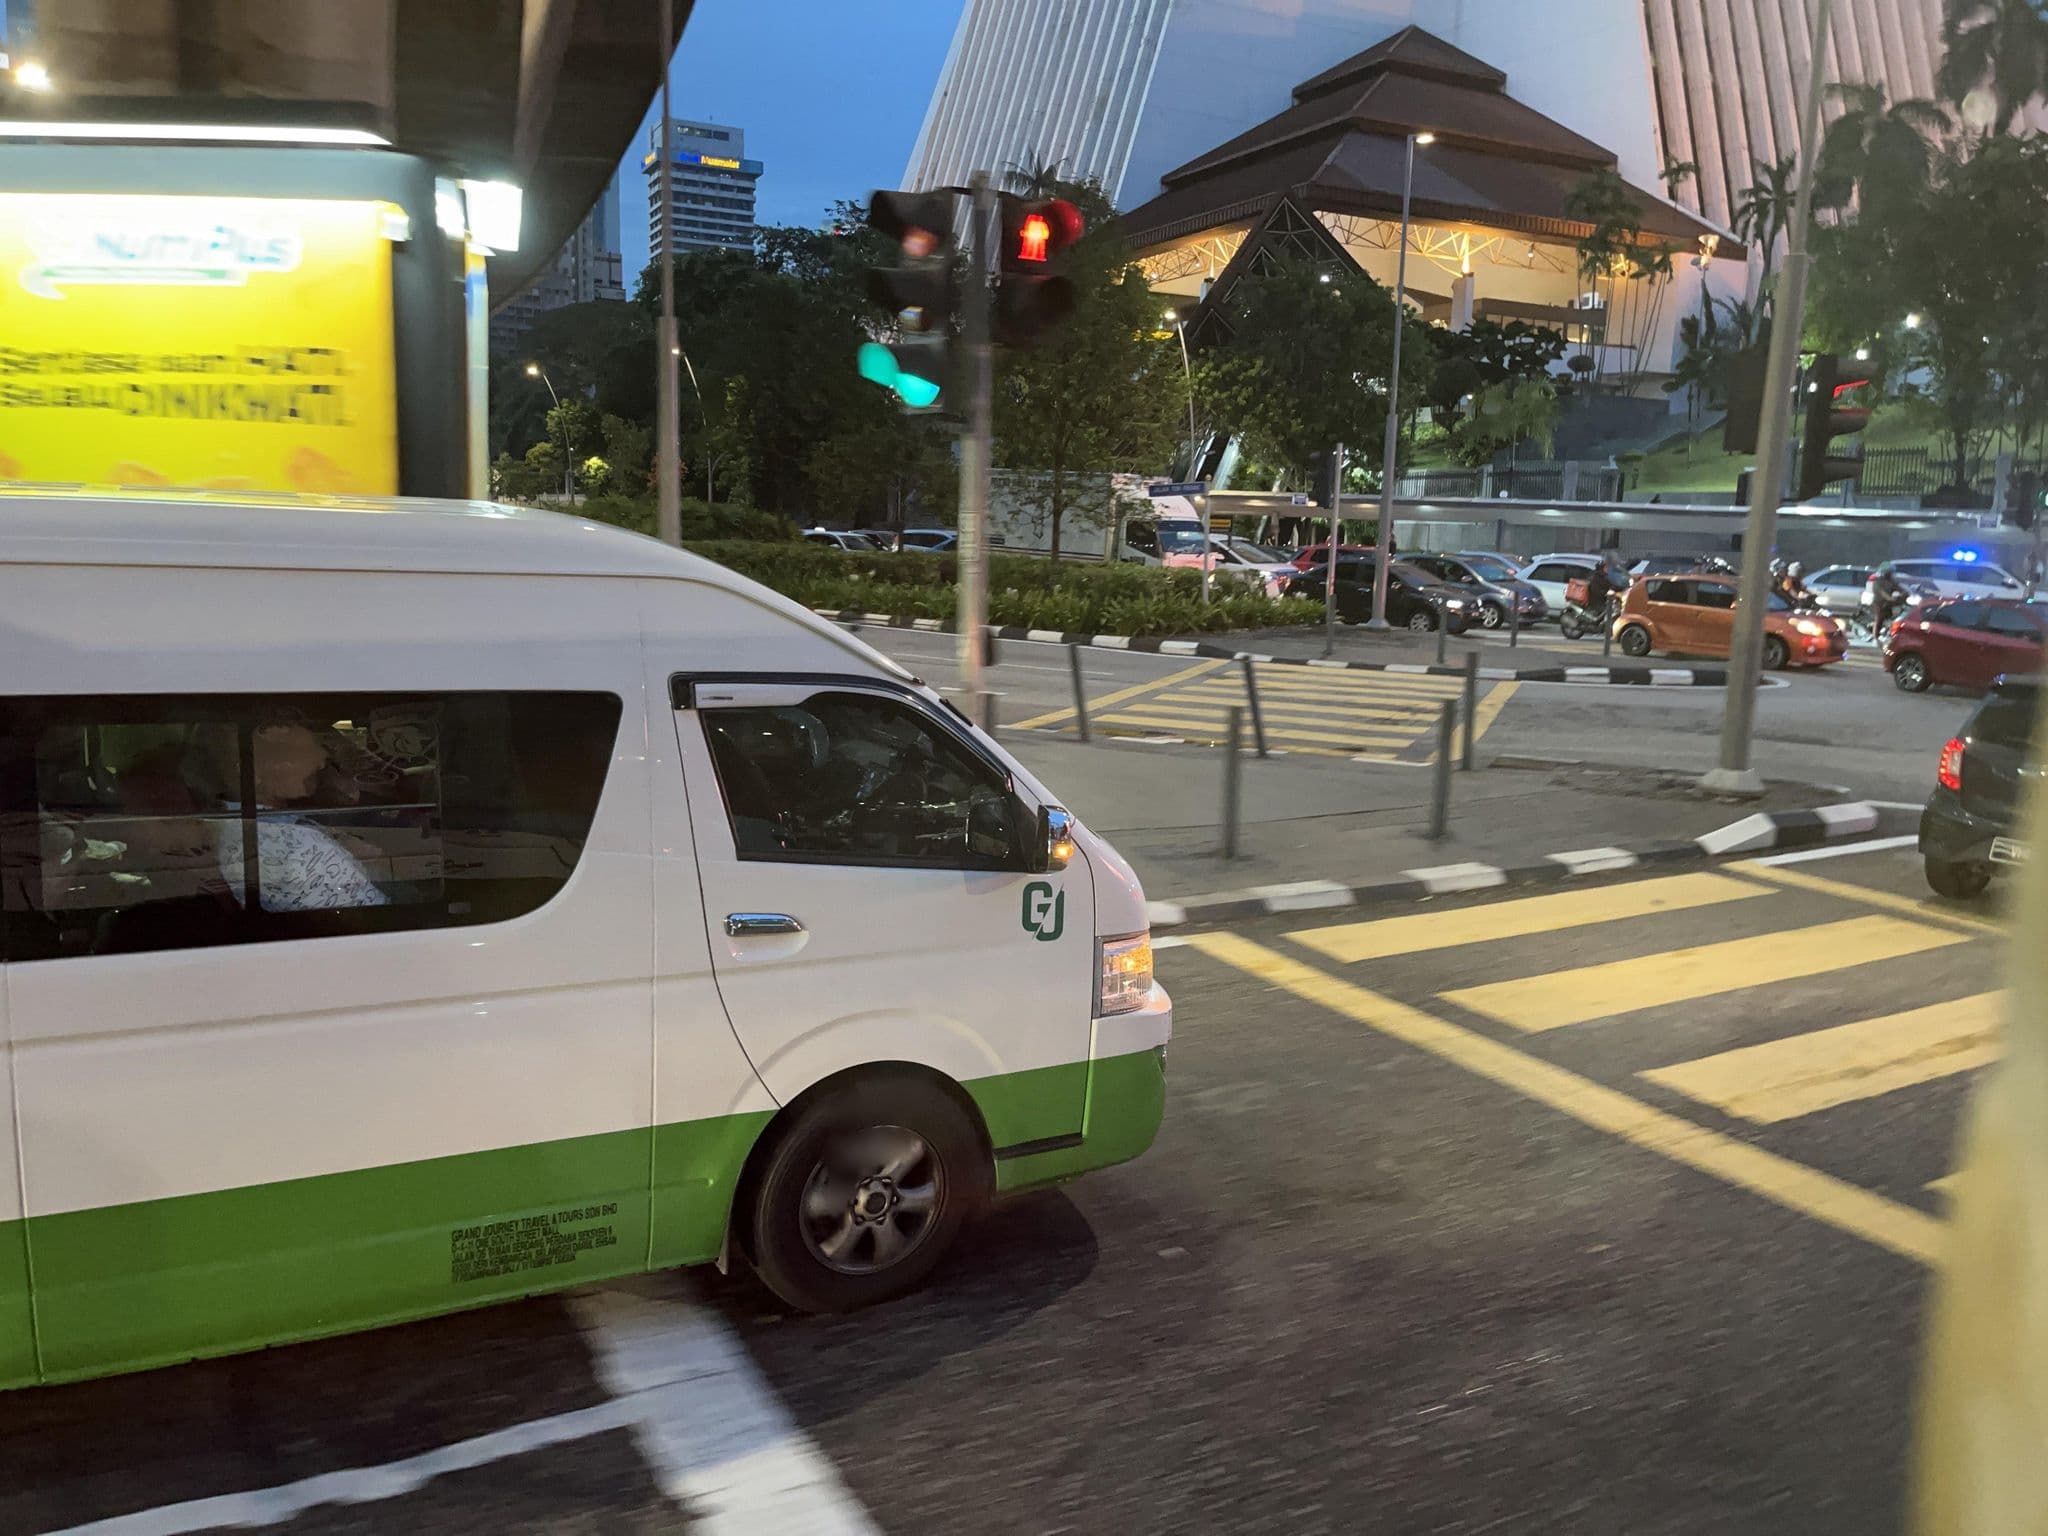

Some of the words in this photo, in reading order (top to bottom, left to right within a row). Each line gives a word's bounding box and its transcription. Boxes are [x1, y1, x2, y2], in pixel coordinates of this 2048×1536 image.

[451, 1226, 481, 1242] GRAND
[482, 1219, 520, 1237] JOURNEY
[521, 1215, 550, 1230] TRAVEL
[558, 1208, 584, 1223] TOURS
[585, 1205, 601, 1219] SDN
[602, 1202, 618, 1216] BHD
